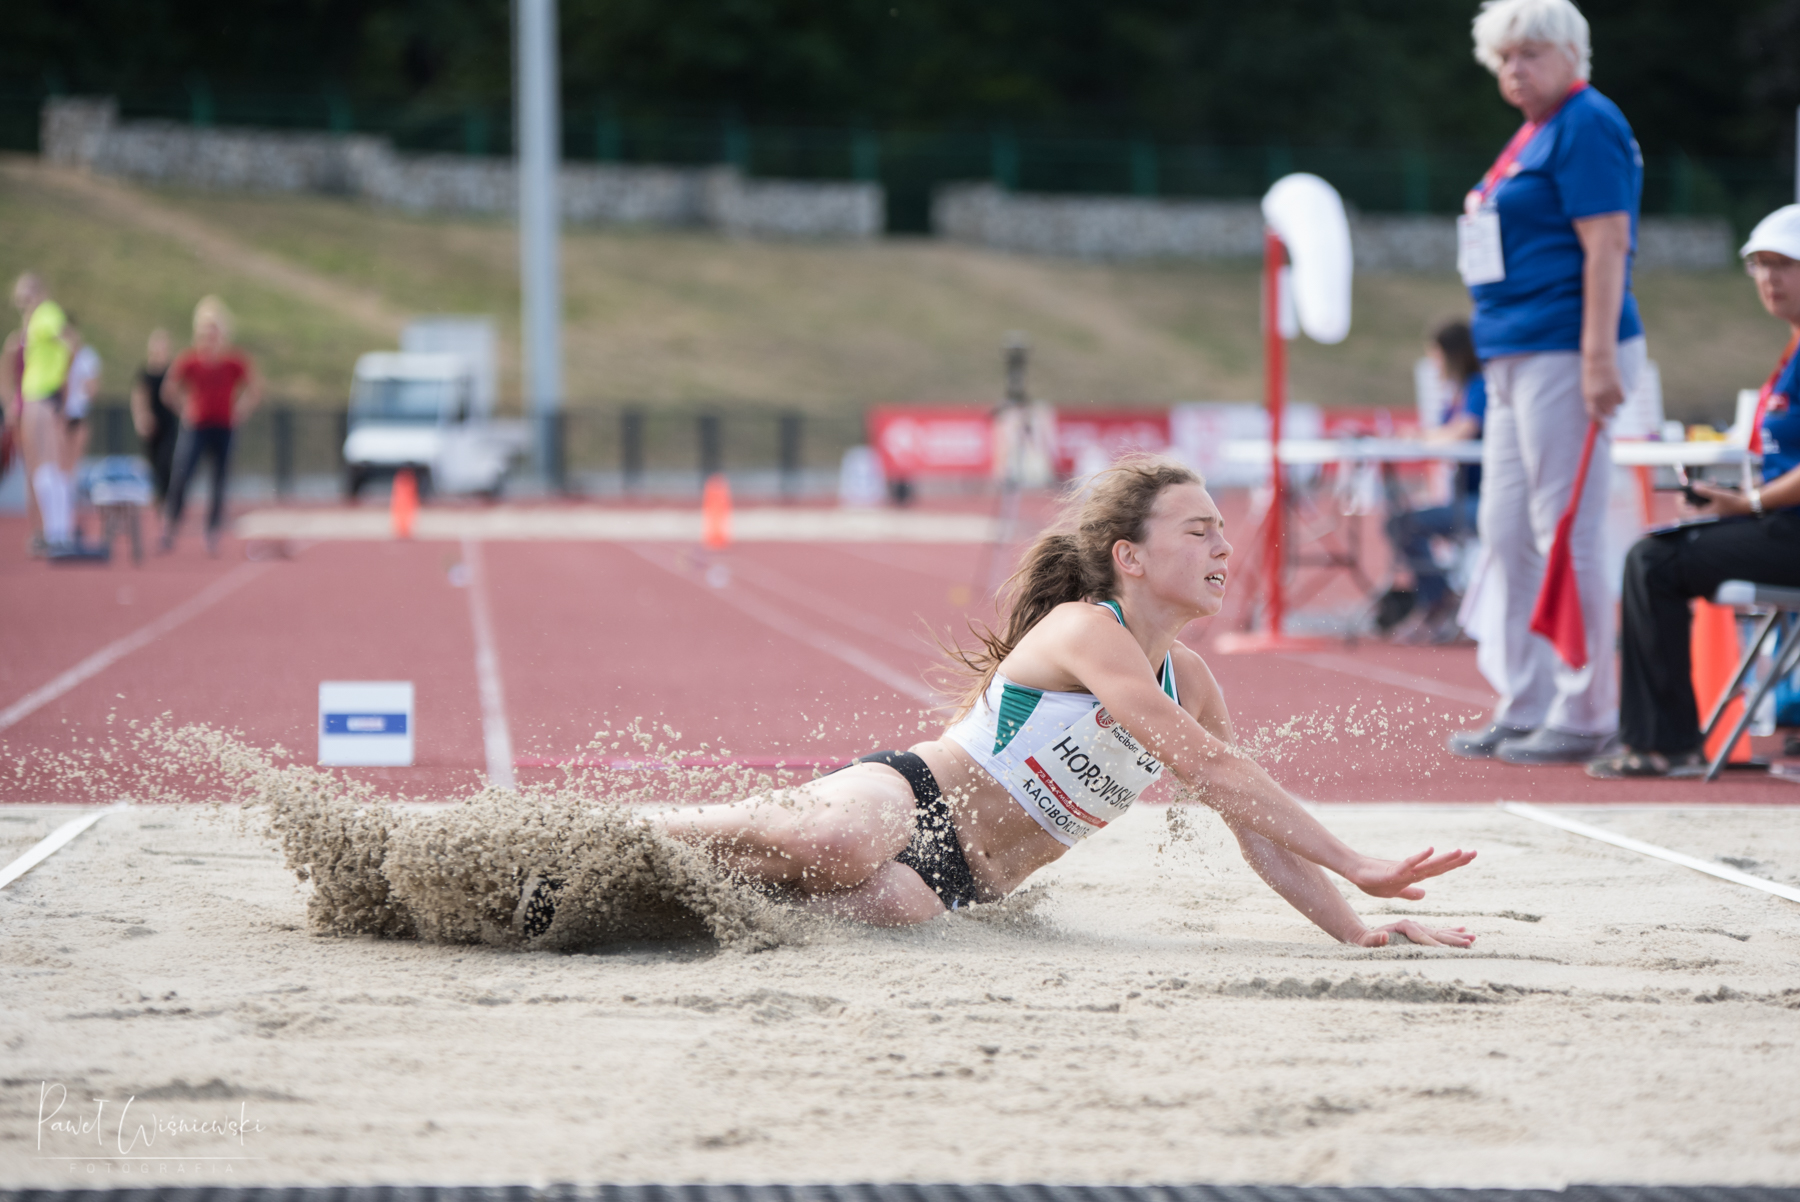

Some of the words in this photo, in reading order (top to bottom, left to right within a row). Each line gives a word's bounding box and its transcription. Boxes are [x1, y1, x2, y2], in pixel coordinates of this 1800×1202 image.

[1111, 726, 1139, 753] Racibórz
[1051, 735, 1138, 813] HOROWSKA
[1022, 778, 1077, 833] RACIBÓRZ
